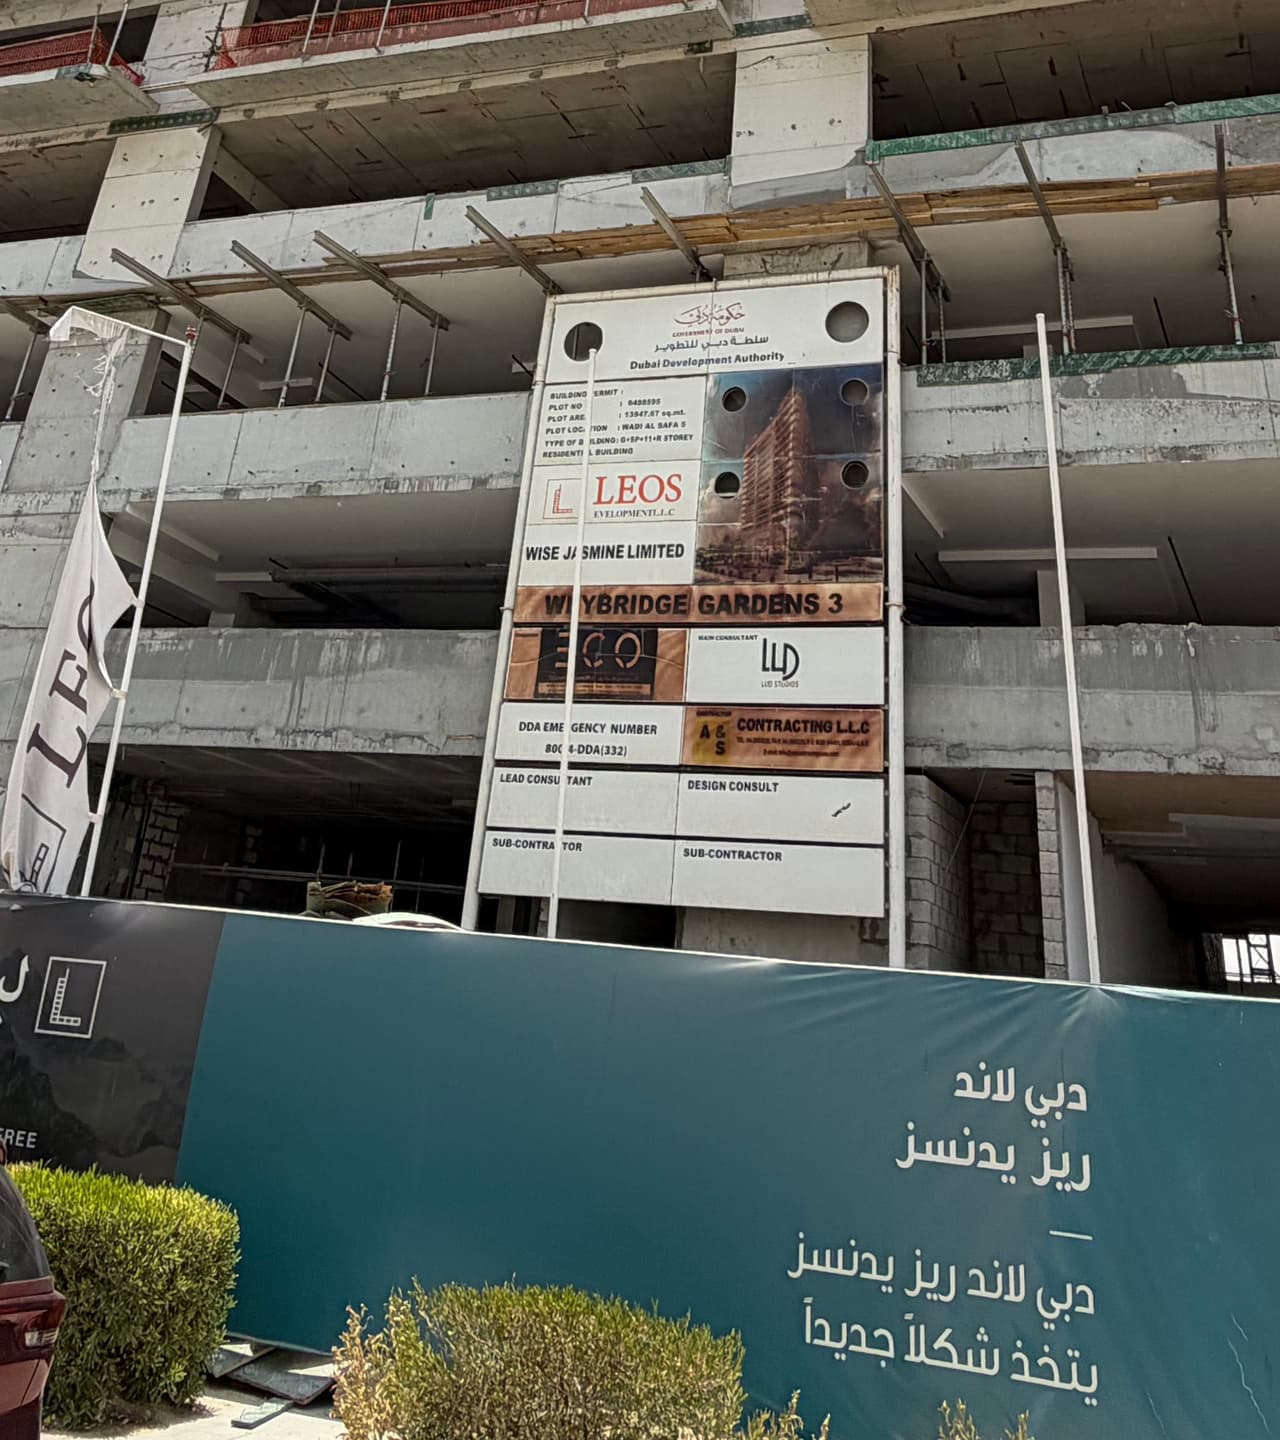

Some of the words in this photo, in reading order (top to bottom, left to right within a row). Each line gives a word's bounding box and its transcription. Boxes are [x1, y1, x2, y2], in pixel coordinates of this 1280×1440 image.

[630, 360, 661, 370] Dubai
[662, 356, 732, 368] Development
[734, 351, 785, 363] Authority
[593, 389, 619, 397] ERMIT
[545, 427, 566, 435] PLOT
[542, 449, 593, 458] RESIDENTIL
[595, 447, 634, 456] BUILDING
[592, 473, 682, 505] LEOS
[526, 546, 560, 560] WISE
[627, 543, 685, 558] LIMITED
[698, 592, 821, 615] GARDENS
[827, 593, 844, 614] 3
[519, 721, 541, 732] DDA
[543, 722, 607, 733] EMEGENCY
[610, 723, 658, 735] NUMBER
[699, 724, 710, 738] A
[736, 718, 833, 733] CONTRACTING
[836, 720, 870, 734] L.L.C
[715, 740, 726, 755] S
[500, 773, 525, 783] LEAD
[527, 774, 593, 786] CONSUTANT
[687, 780, 727, 791] DESIGN
[729, 781, 780, 793] CONSULT
[492, 838, 583, 852] SUB-CONTRATOR
[683, 848, 783, 862] SUB-CONTRACTOR
[954, 1061, 1016, 1102] لاند
[1024, 1081, 1088, 1128] دبي
[895, 1121, 1017, 1185] يدنسز
[1031, 1137, 1093, 1192] ريز
[786, 1231, 894, 1293] يدنسز
[904, 1248, 956, 1302] ريز
[966, 1260, 1026, 1303] لاند
[1036, 1282, 1095, 1330] دبي
[803, 1296, 895, 1368] جديداً
[902, 1313, 1000, 1377] شكلاً
[1010, 1340, 1099, 1407] يتخذ
